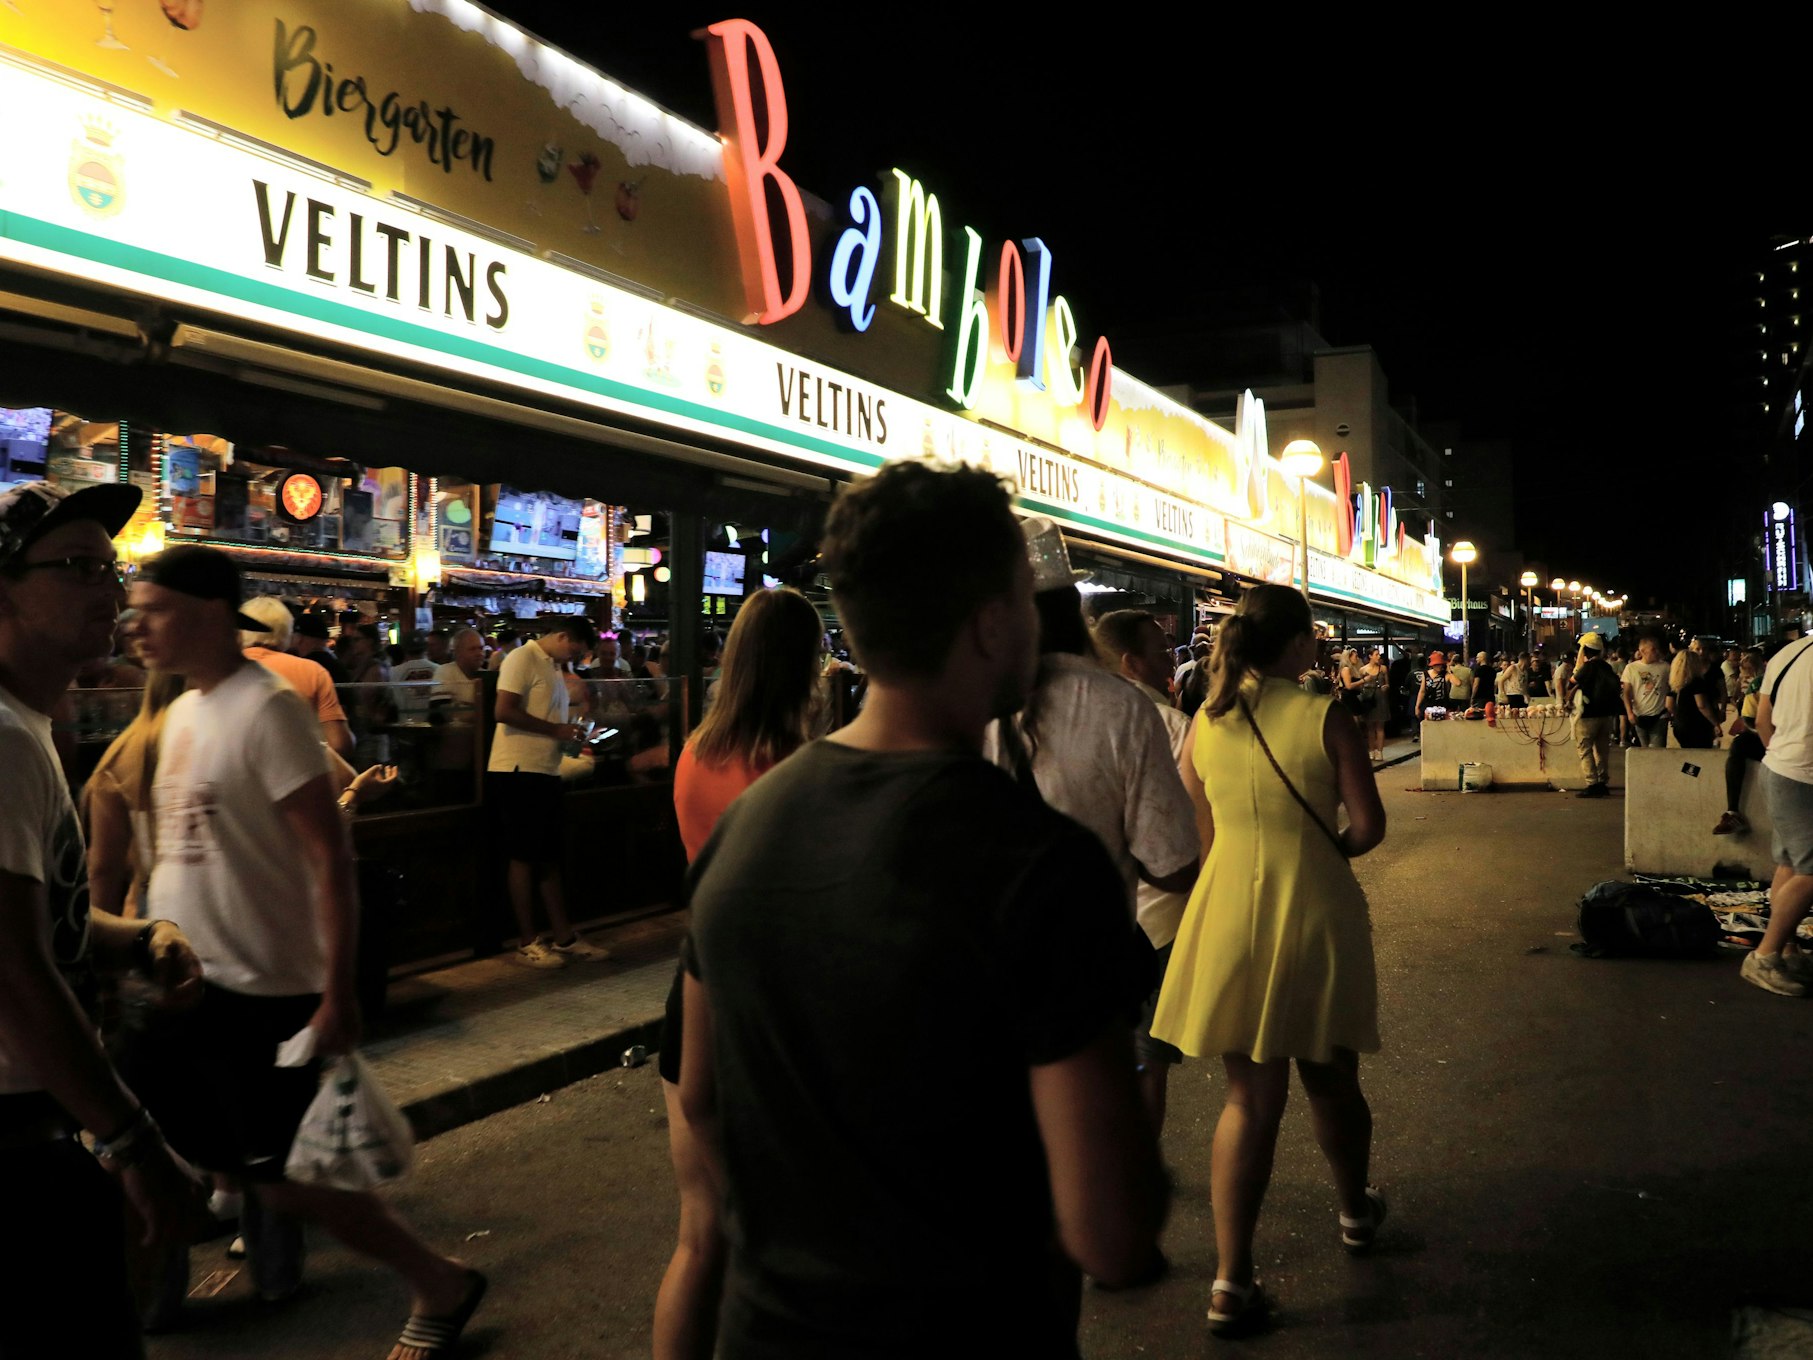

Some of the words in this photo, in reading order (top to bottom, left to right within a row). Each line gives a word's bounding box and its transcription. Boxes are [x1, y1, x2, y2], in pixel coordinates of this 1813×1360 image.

[273, 17, 496, 182] Biergarten
[253, 179, 509, 331] VELTINS
[700, 18, 1113, 431] Bamboleo
[776, 362, 888, 446] VELTINS
[1018, 449, 1079, 503] VELTINS
[1155, 499, 1193, 539] VELTINS
[1308, 555, 1327, 580] ELTINS
[1450, 597, 1488, 610] Bihaus
